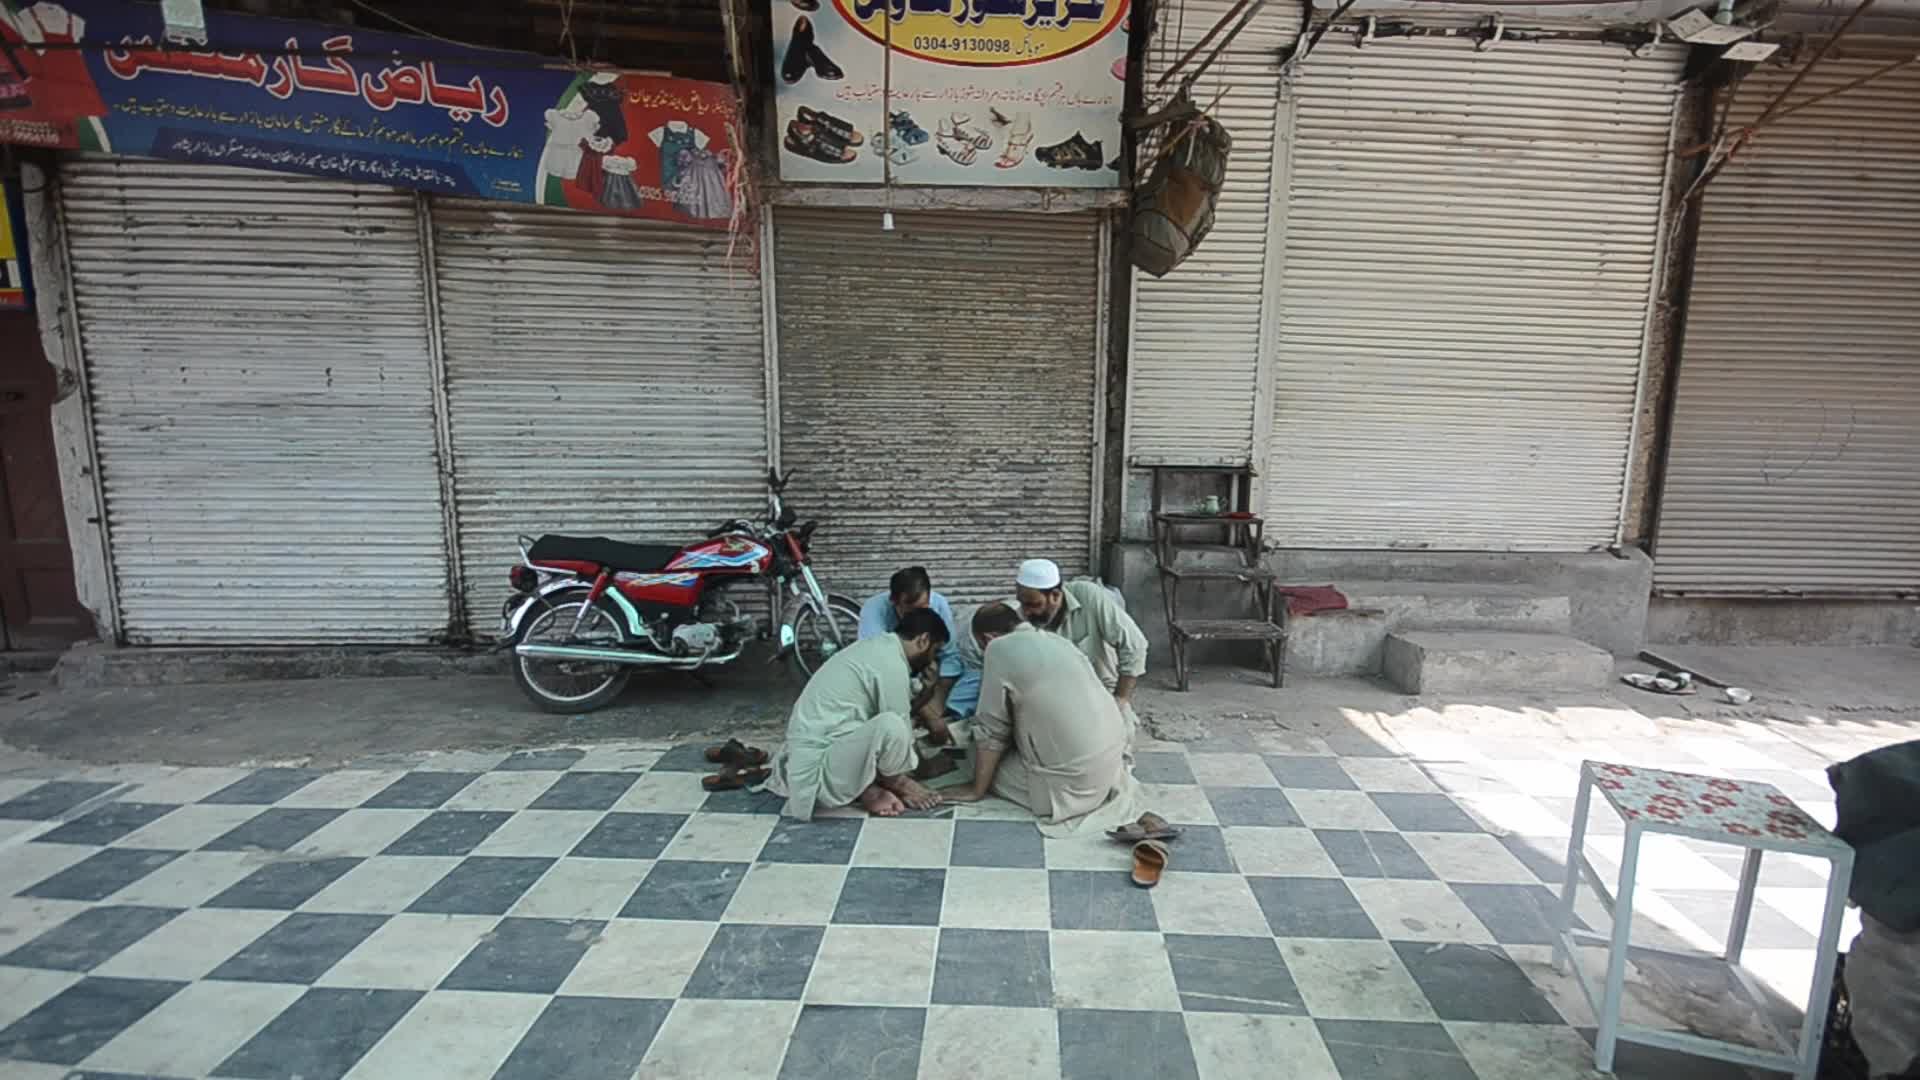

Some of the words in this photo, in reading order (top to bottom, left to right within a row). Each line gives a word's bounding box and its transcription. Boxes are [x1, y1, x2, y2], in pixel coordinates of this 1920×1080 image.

[913, 36, 1011, 53] 0304-9130098
[361, 49, 509, 127] ریاض
[853, 83, 885, 101] ستیاب
